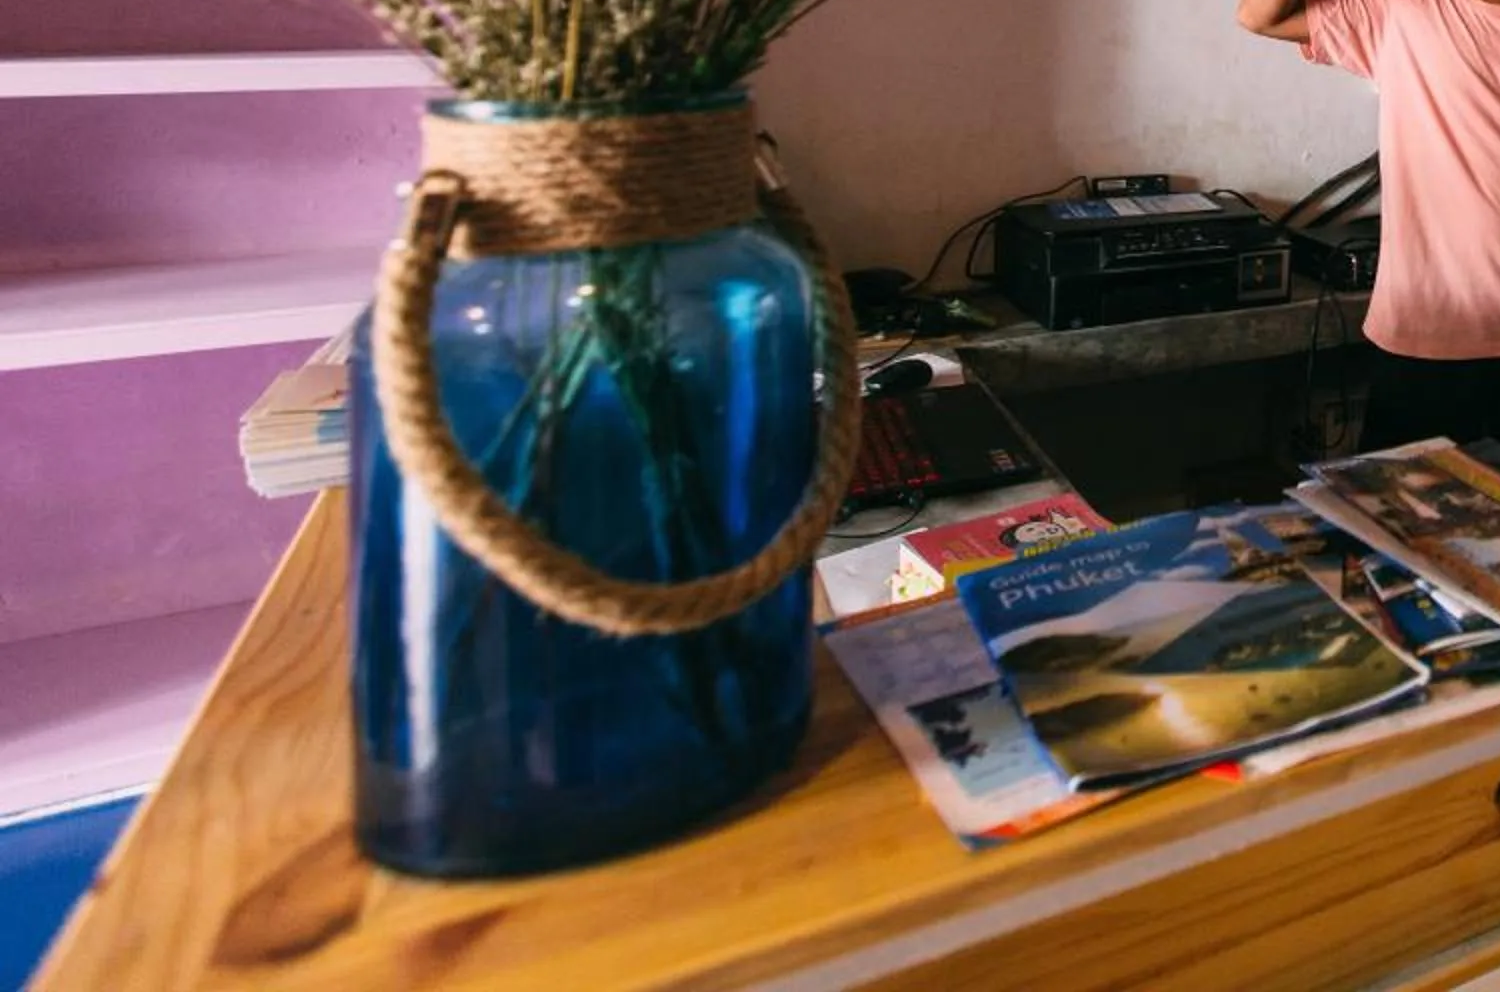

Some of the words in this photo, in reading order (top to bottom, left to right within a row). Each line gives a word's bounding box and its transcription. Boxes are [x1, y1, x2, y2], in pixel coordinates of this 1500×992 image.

[989, 562, 1062, 590] Guide
[1069, 548, 1122, 568] map
[1125, 540, 1151, 553] to
[999, 560, 1143, 609] Phuket
